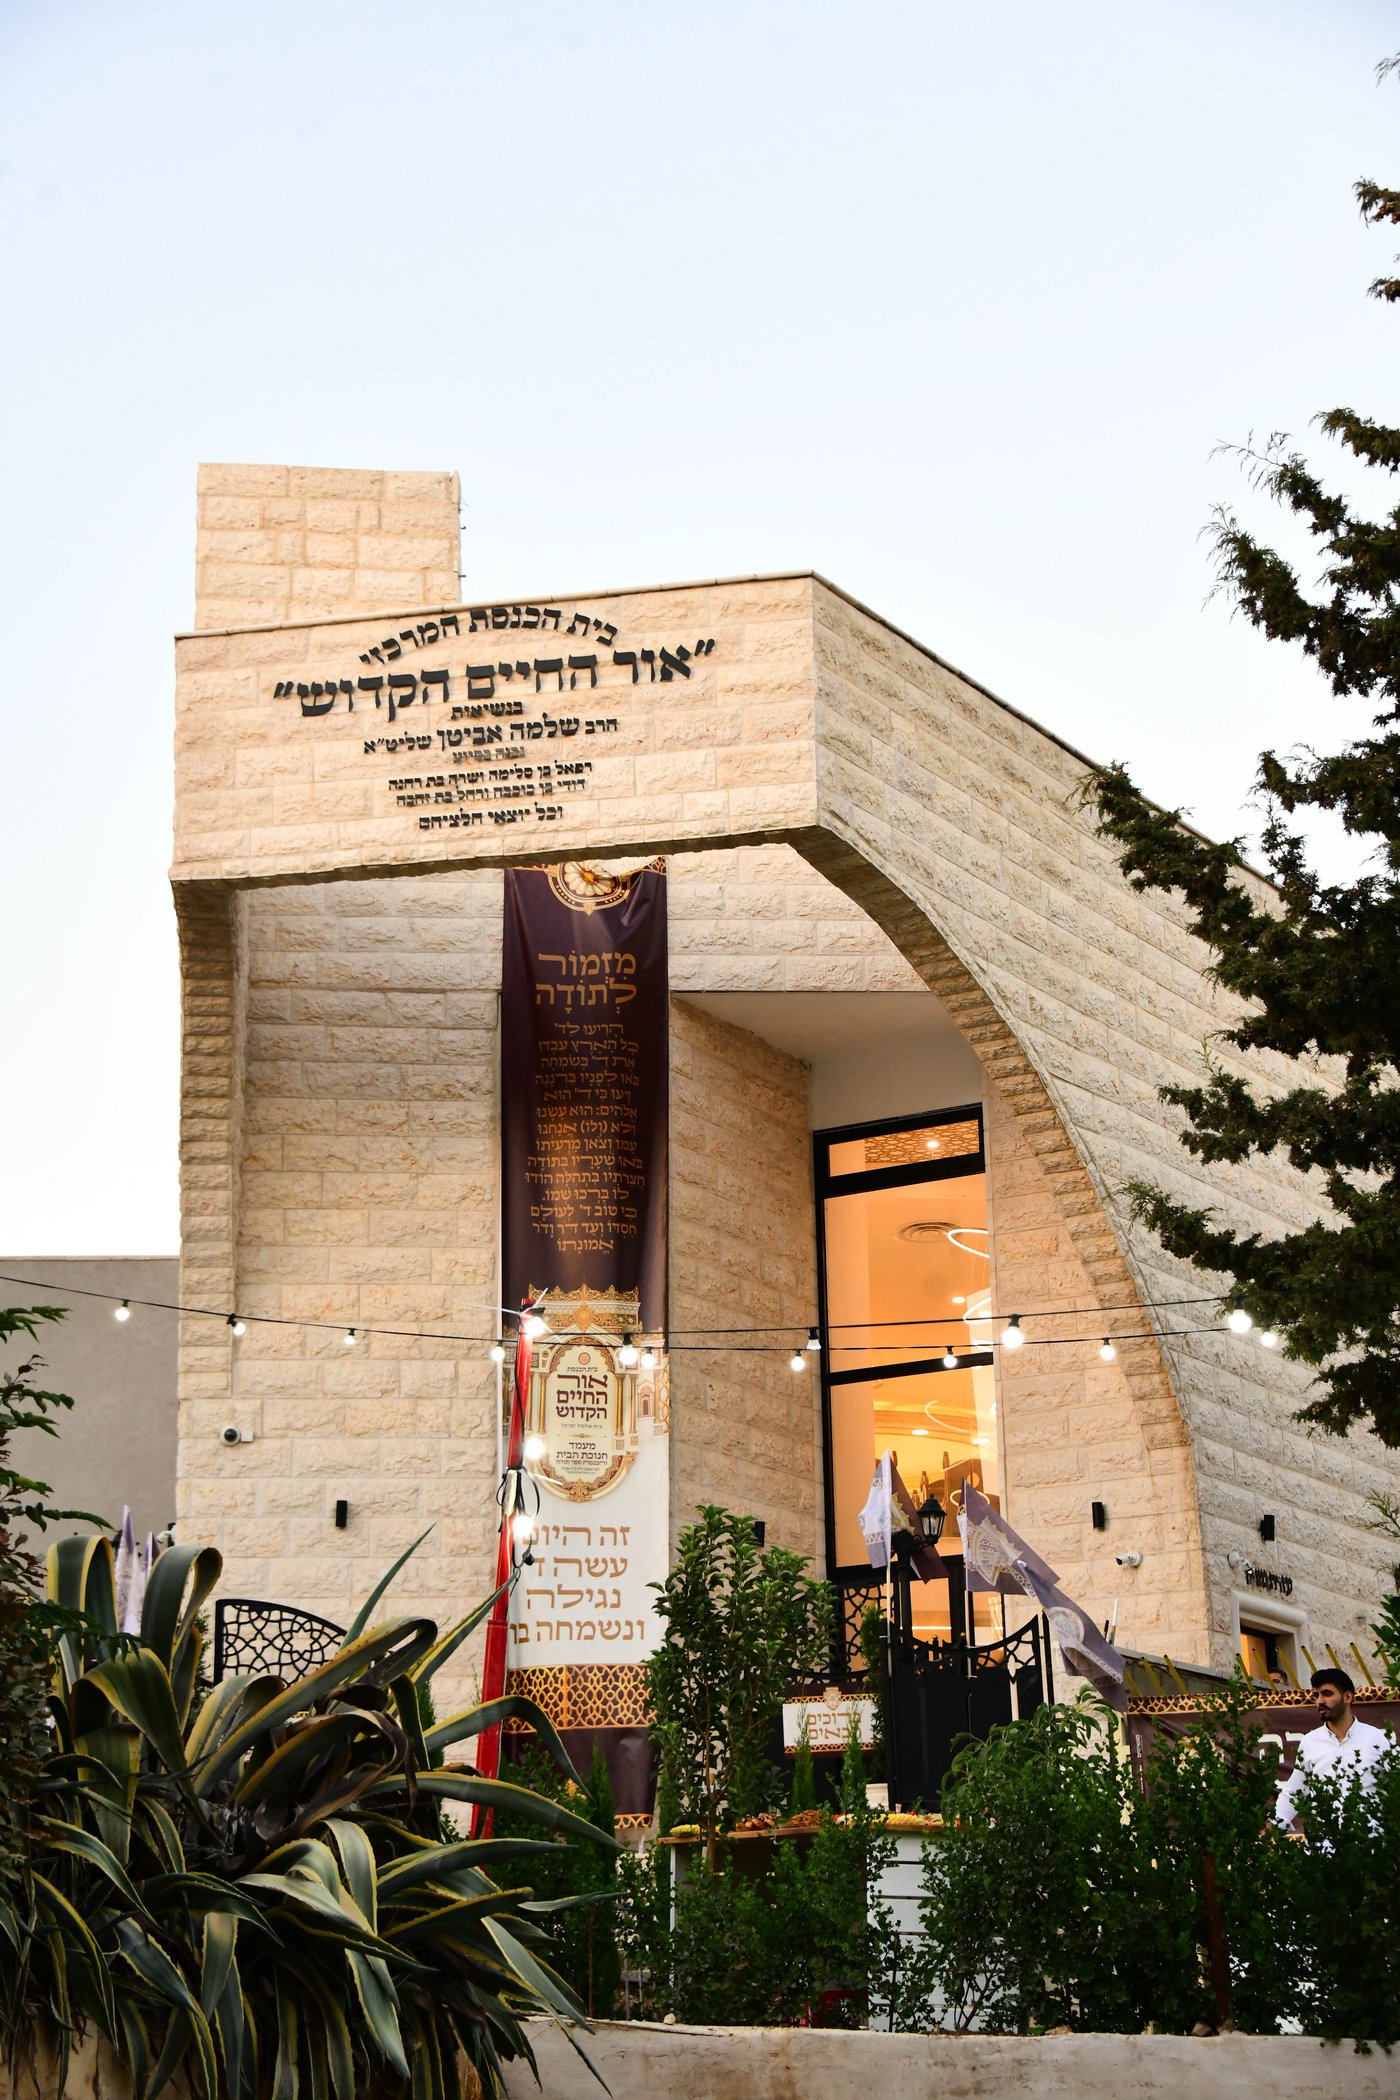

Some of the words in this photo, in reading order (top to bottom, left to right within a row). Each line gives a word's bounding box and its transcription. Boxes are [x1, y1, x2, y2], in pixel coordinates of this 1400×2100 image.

[469, 606, 561, 633] הכנסת
[566, 613, 618, 647] בית
[359, 615, 460, 664] המרכזי
[465, 654, 597, 699] החיים
[450, 701, 524, 720] בנשיאות
[510, 712, 579, 740] שלמה
[585, 717, 618, 735] הרב
[437, 724, 502, 751] אביטן
[489, 763, 533, 780] סלימה
[537, 765, 551, 779] בן
[555, 759, 592, 775] רפאל
[426, 775, 445, 788] בת
[449, 771, 484, 785] ושרה
[557, 778, 586, 792] דודי
[434, 791, 452, 804] בת
[456, 786, 489, 801] ורחל
[539, 782, 553, 797] בן
[419, 807, 483, 830] חלציהם
[488, 808, 531, 824] יוצאי
[533, 801, 563, 821] וכל
[557, 1374, 608, 1389] אור
[556, 1389, 608, 1405] החיים
[556, 1406, 607, 1422] הקדוש
[569, 1441, 596, 1450] מעמד
[556, 1451, 579, 1459] הבית
[581, 1452, 608, 1460] חנוכת
[599, 1526, 631, 1546] זה
[553, 1557, 628, 1578] עשה
[526, 1584, 622, 1610] נגילה
[510, 1623, 530, 1644] בו
[536, 1620, 645, 1642] ונשמחה
